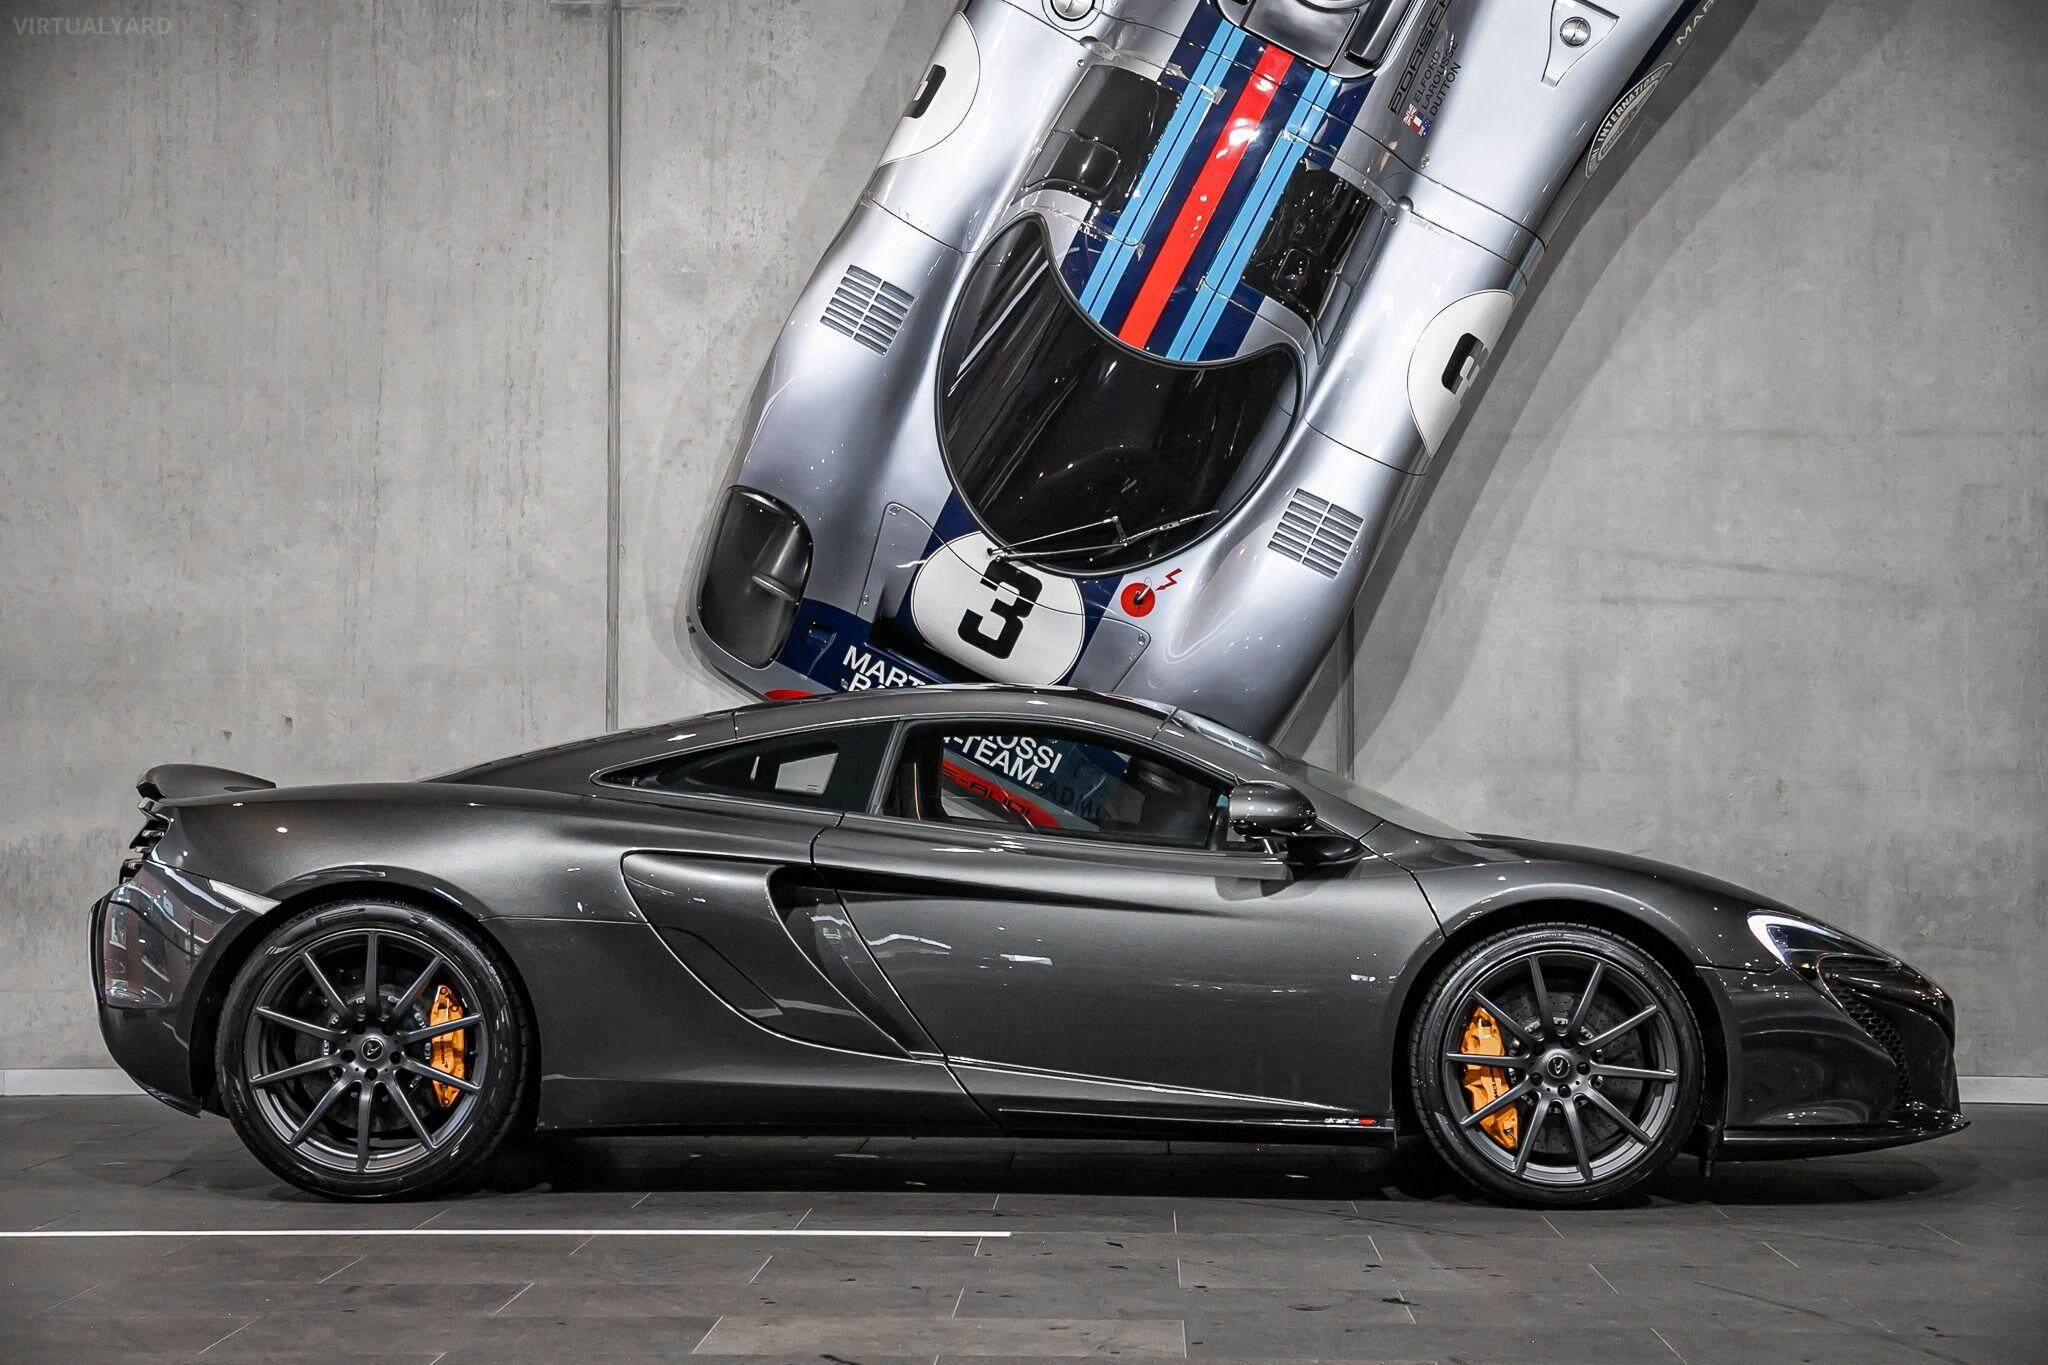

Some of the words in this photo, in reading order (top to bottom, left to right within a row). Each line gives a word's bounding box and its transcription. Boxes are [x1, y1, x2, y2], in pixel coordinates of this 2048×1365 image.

[1413, 51, 1441, 103] ELFORD
[1421, 42, 1459, 110] LAROUSSE
[1430, 62, 1462, 116] DUTTON
[958, 558, 1042, 659] 3
[988, 735, 1063, 774] OSSI
